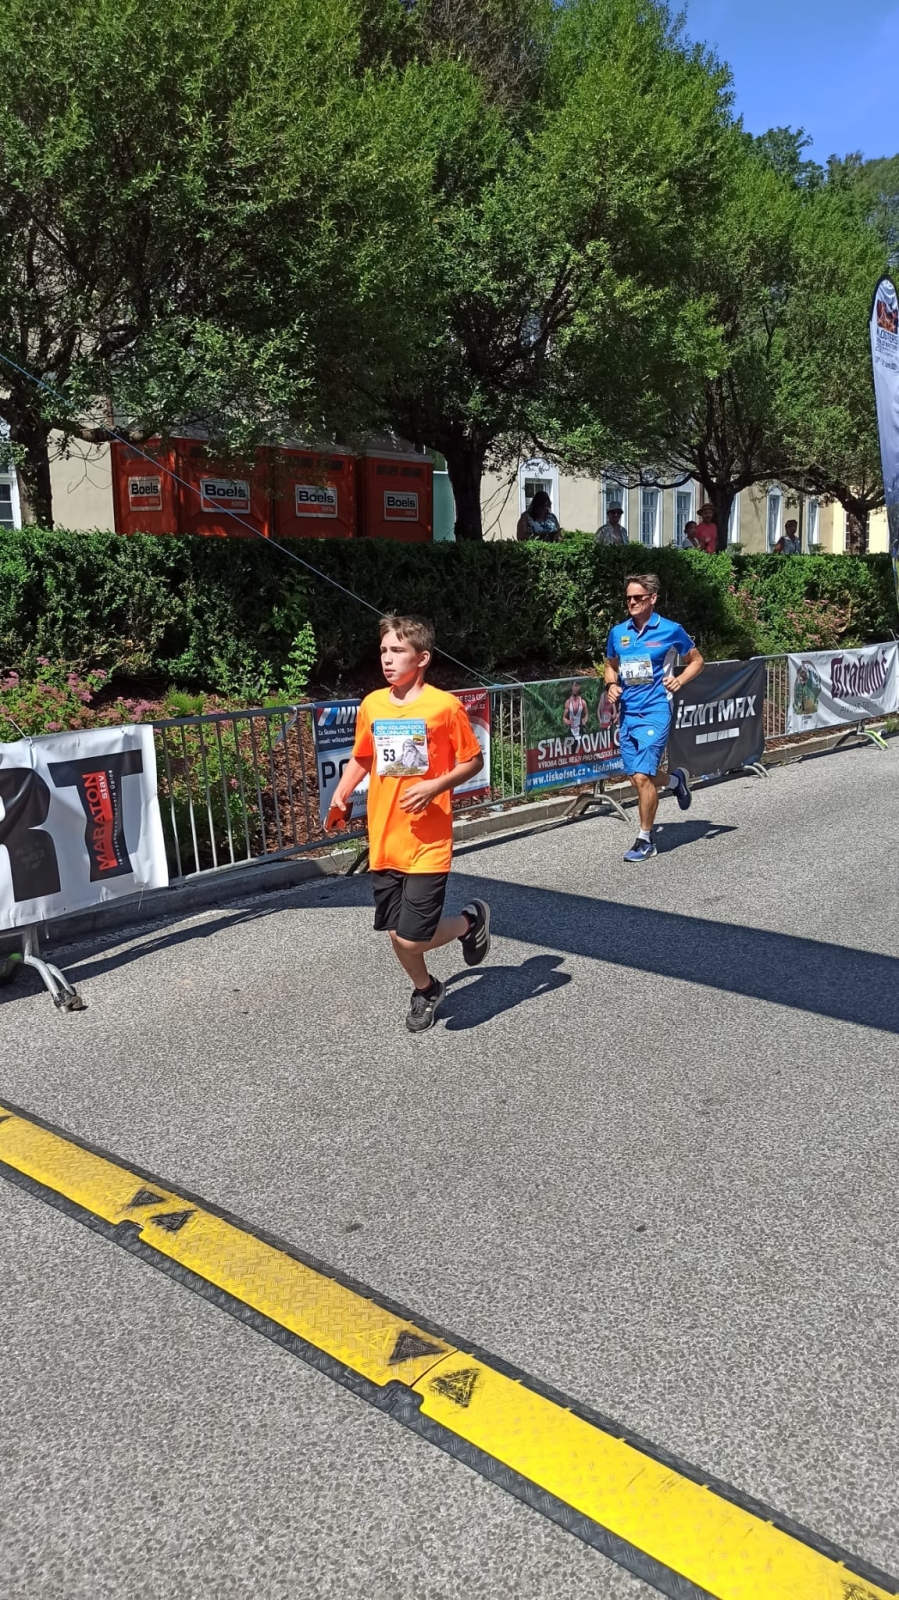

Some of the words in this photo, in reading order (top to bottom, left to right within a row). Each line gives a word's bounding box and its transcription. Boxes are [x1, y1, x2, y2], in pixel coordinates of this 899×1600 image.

[131, 482, 159, 495] Boels
[205, 484, 247, 498] Boels
[299, 490, 334, 503] Boels
[387, 496, 416, 508] Boels
[625, 670, 634, 678] 81
[537, 725, 611, 760] STARTOVNÍ
[383, 748, 396, 762] 53
[98, 775, 108, 799] stav
[82, 772, 112, 871] MARATON
